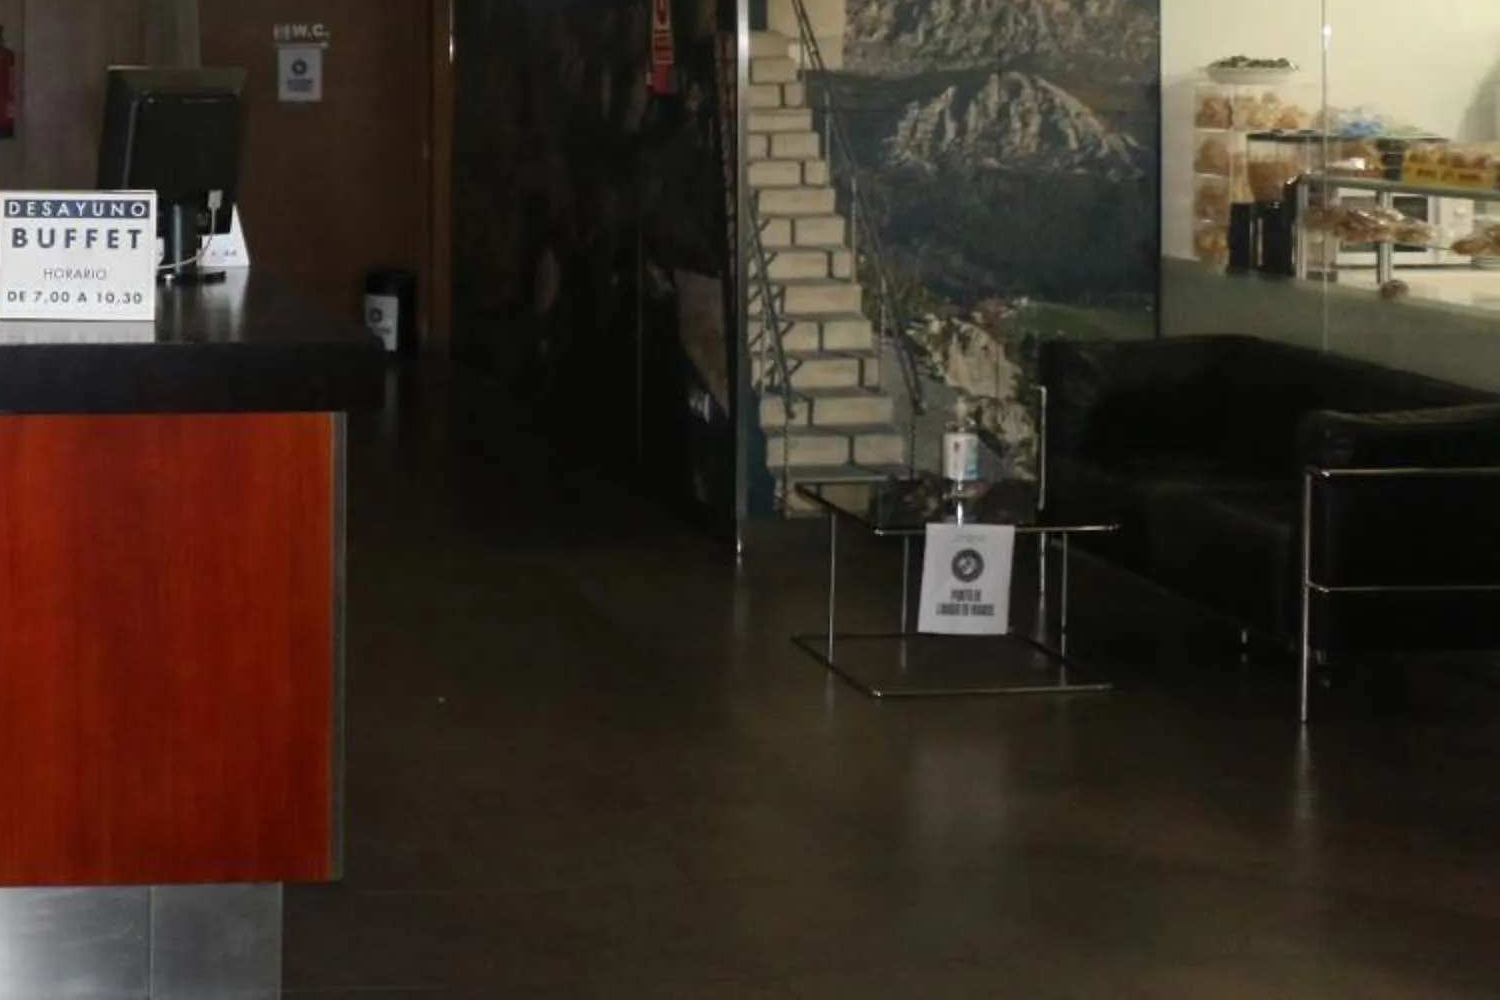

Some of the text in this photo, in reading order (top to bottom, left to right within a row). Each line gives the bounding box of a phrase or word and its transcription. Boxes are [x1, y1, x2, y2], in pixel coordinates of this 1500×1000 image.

[8, 200, 146, 217] DESAYUNO
[12, 228, 142, 249] BUFFET
[43, 267, 107, 280] HORARIO
[7, 291, 26, 303] DE
[77, 292, 87, 304] A
